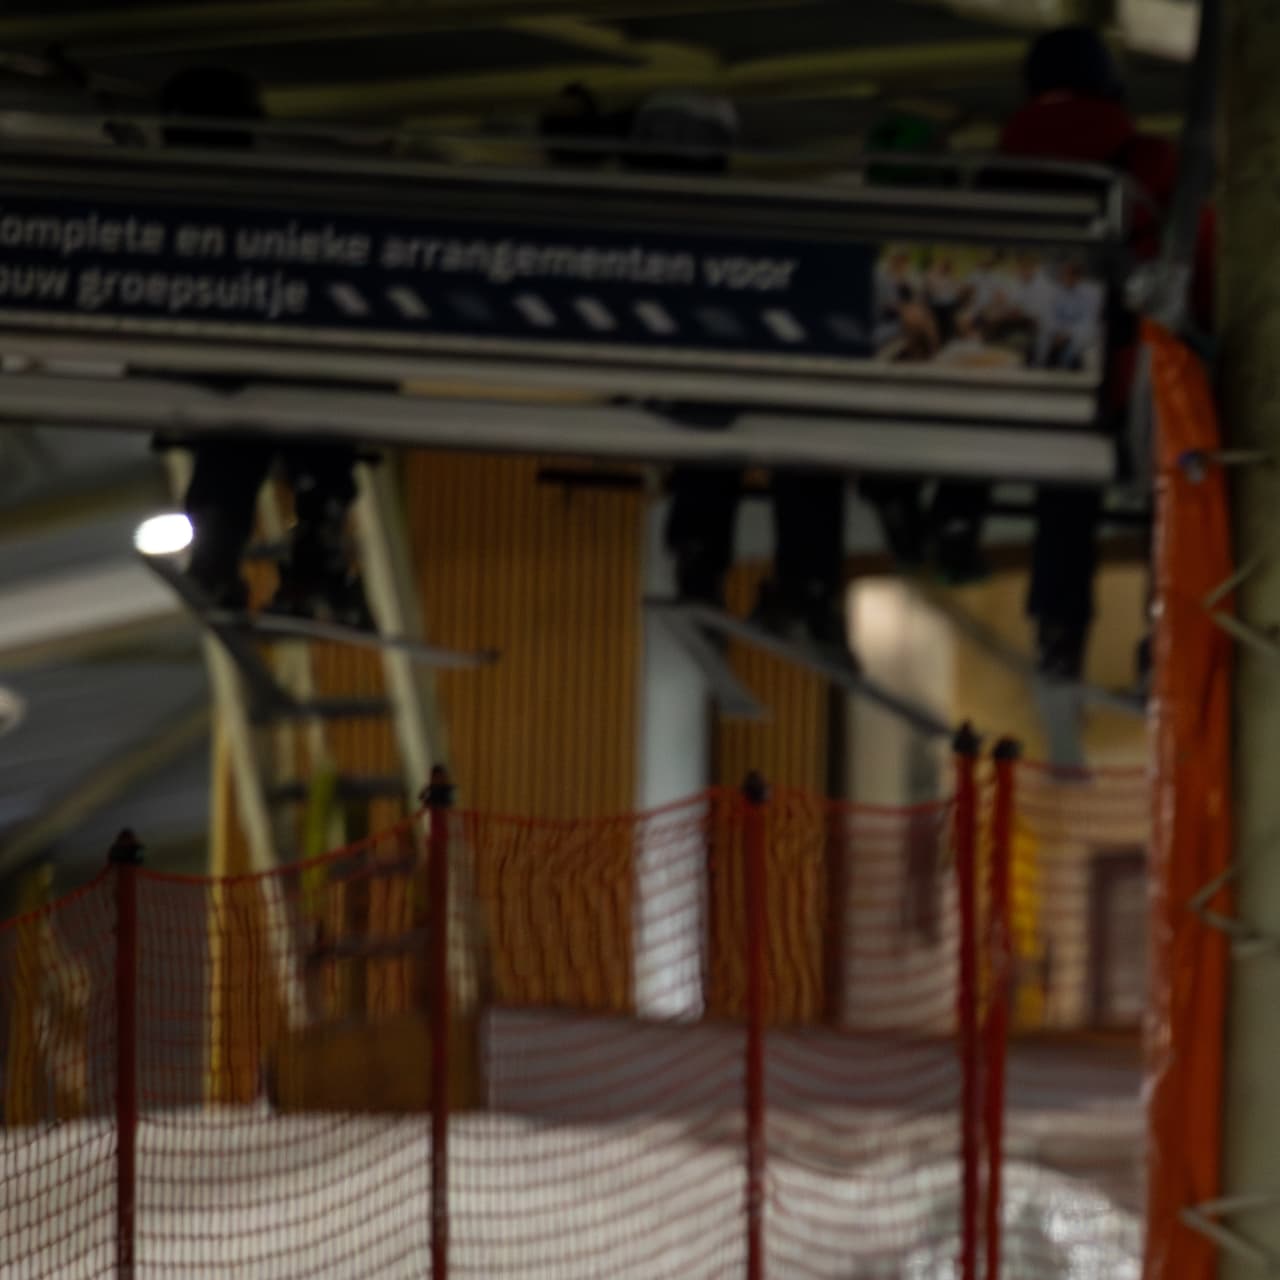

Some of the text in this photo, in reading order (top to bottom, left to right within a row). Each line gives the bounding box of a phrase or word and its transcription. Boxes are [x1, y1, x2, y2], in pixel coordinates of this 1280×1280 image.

[0, 207, 798, 291] omplete en unieke arrangementen voor
[75, 267, 309, 319] groepsuitje
